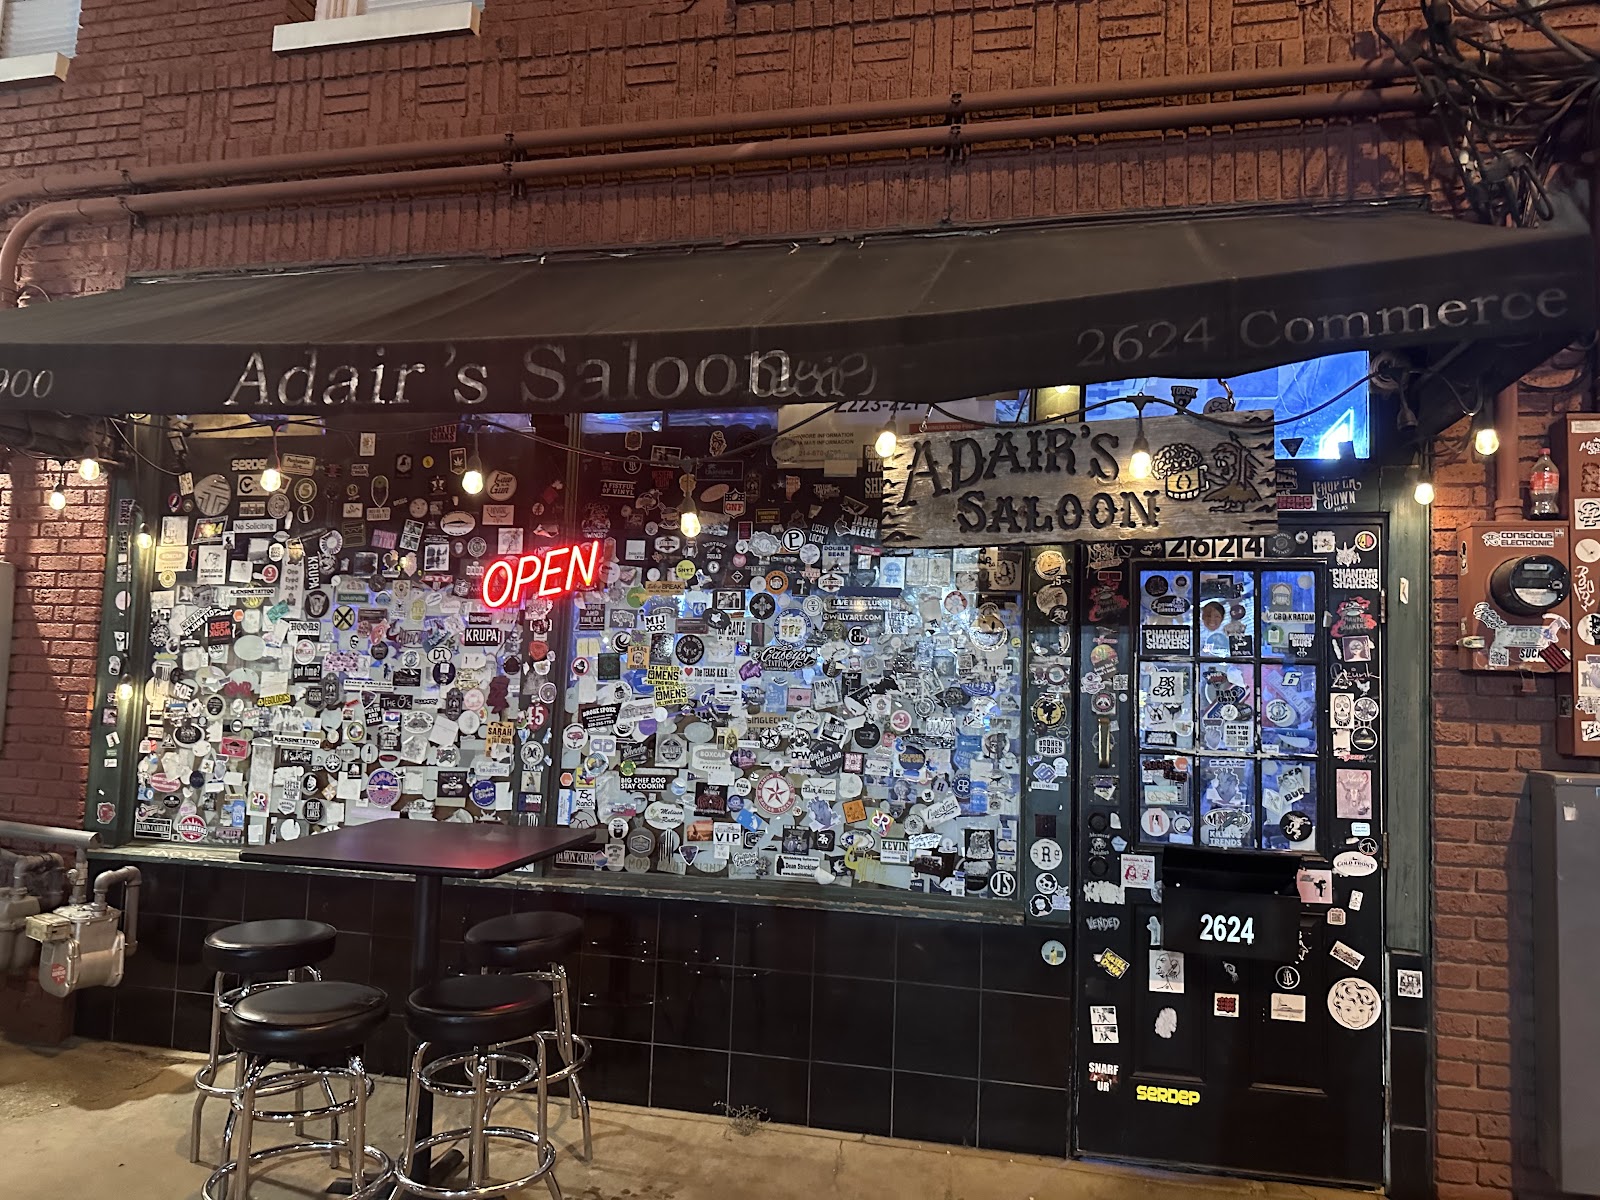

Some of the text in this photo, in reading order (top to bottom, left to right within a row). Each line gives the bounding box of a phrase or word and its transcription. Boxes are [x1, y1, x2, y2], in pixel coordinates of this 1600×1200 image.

[1077, 287, 1570, 368] 2624 Commerce
[223, 346, 488, 406] Adair's
[901, 424, 1121, 507] ADAIR'S
[953, 489, 1161, 534] SALOON
[235, 521, 274, 532] No Soliciting
[1167, 538, 1263, 558] 2624
[482, 540, 599, 608] OPEN
[1332, 579, 1378, 590] SHAKERS
[1288, 612, 1315, 621] KRATOM
[210, 621, 230, 630] DEEP
[465, 628, 498, 642] KRUPA
[1145, 629, 1190, 639] PHANTOM
[1145, 638, 1190, 650] SHAKERS
[704, 667, 716, 677] TEXAS
[488, 727, 512, 737] SARAH
[715, 832, 740, 842] VIP
[1209, 838, 1242, 846] TRENDS
[882, 840, 909, 852] KEVIN
[1086, 916, 1120, 931] VENDED
[1200, 914, 1255, 945] 2624
[1088, 1062, 1119, 1076] SNARF
[1096, 1081, 1110, 1092] UR
